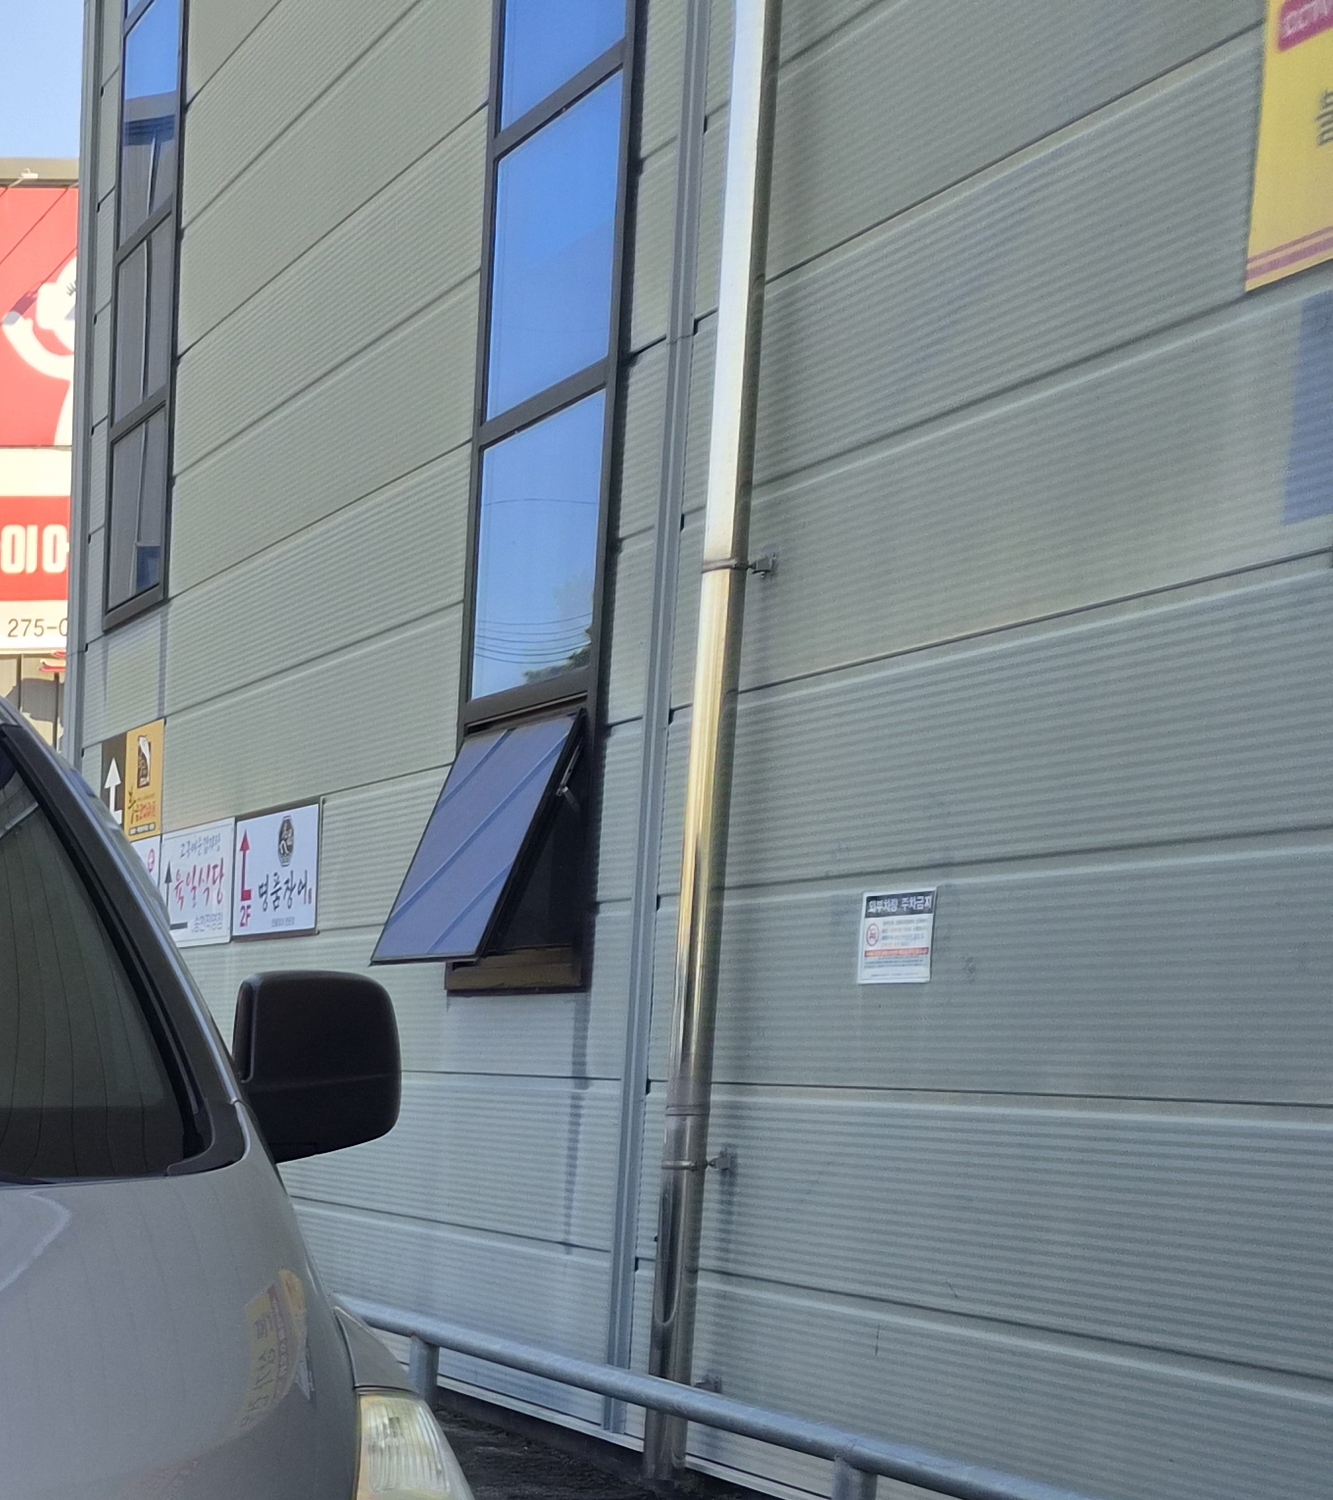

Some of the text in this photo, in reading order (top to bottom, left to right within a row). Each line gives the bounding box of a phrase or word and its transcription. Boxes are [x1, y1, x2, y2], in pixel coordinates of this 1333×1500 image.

[174, 857, 225, 911] 육일식당
[258, 869, 308, 912] 명품장어
[239, 904, 252, 928] 2F
[868, 895, 932, 913] 외부차량 주차금지
